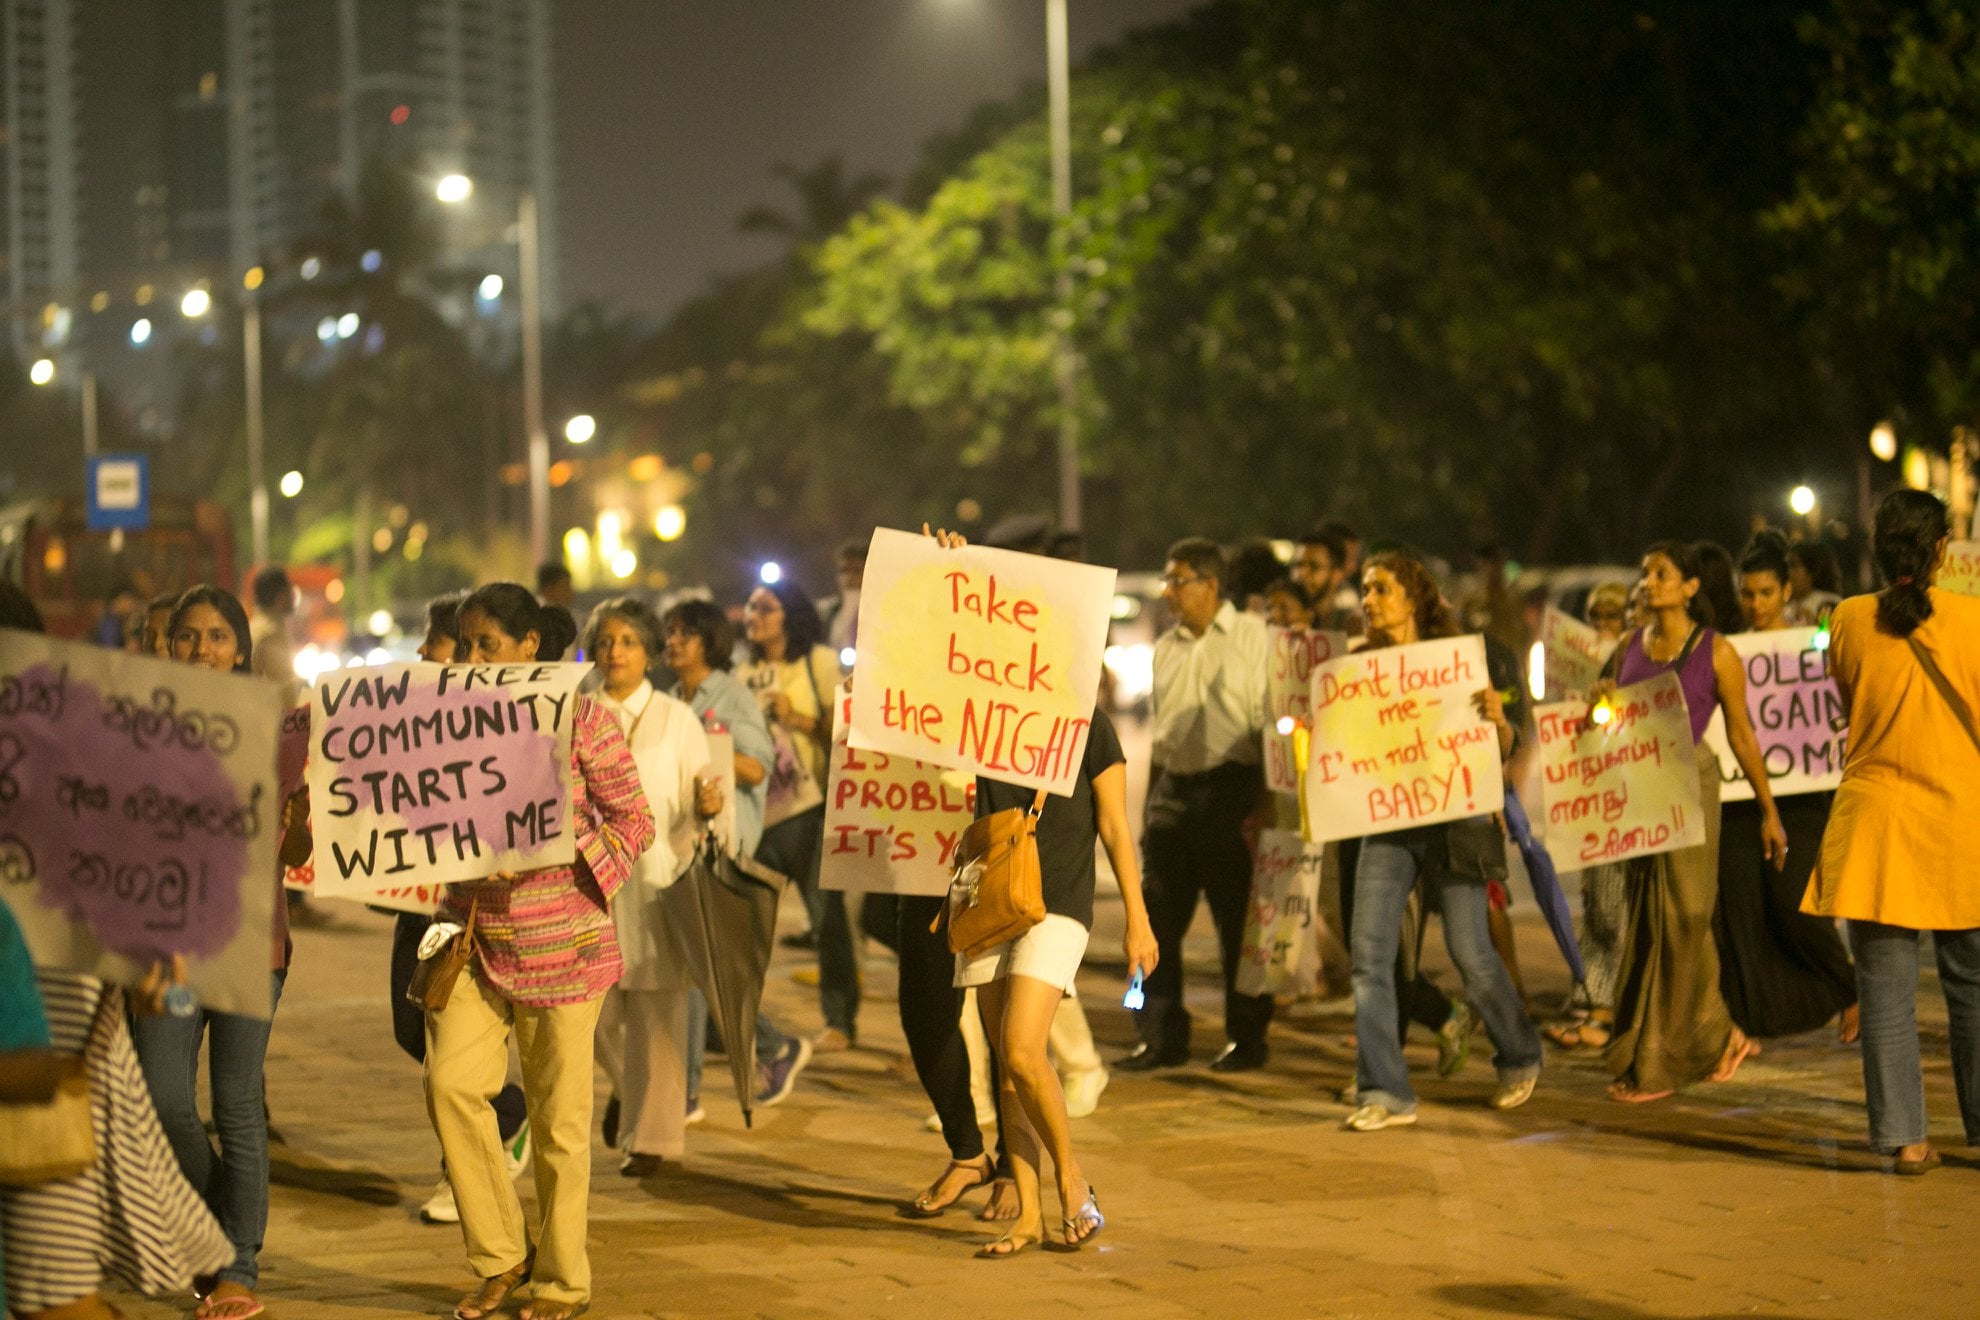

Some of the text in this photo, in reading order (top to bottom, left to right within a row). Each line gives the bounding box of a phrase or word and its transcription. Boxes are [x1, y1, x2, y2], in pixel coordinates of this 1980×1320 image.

[945, 572, 1038, 633] Take
[321, 665, 560, 717] VAW FREE
[948, 633, 1053, 692] back
[1318, 656, 1390, 710] Don't
[1400, 650, 1473, 695] touch
[322, 693, 568, 762] COMMUNITY
[881, 688, 1089, 783] the NIGHT
[1386, 726, 1429, 766] not
[1438, 726, 1491, 766] your
[328, 756, 506, 816] STARTS
[835, 779, 976, 813] PROBLE
[1368, 764, 1475, 822] BABY!
[332, 798, 561, 880] WITH ME
[831, 825, 917, 861] IT'S
